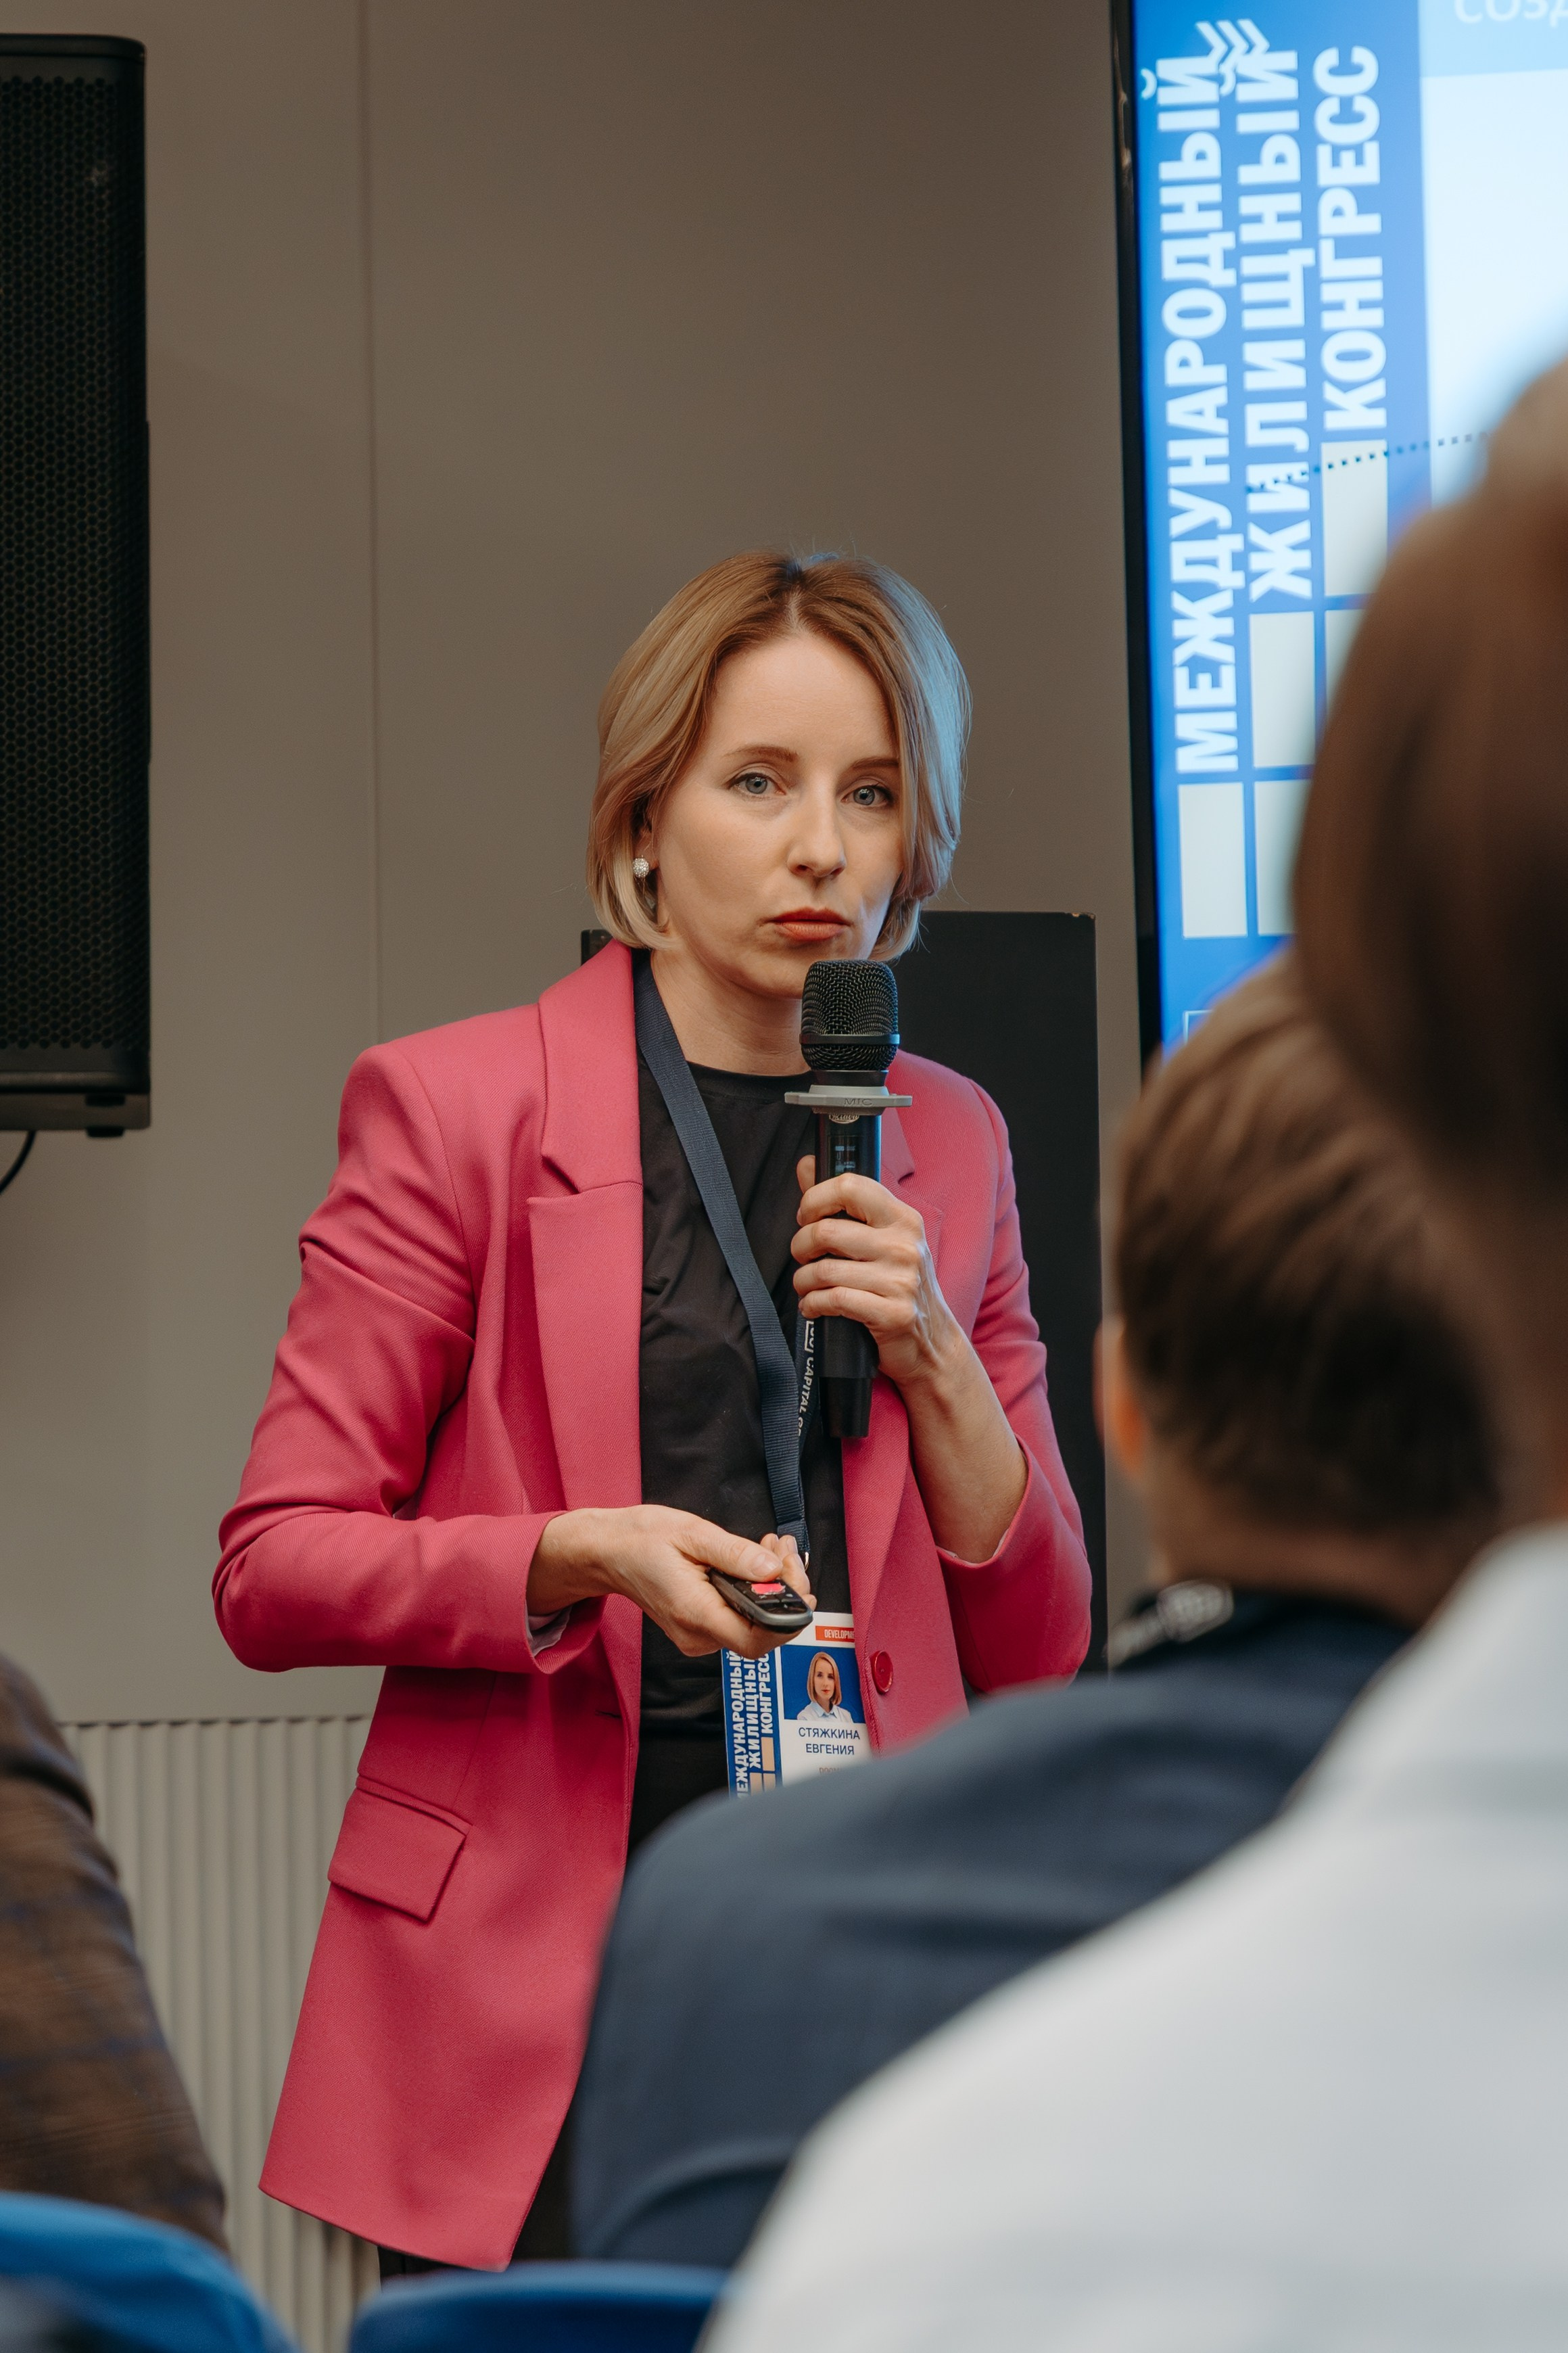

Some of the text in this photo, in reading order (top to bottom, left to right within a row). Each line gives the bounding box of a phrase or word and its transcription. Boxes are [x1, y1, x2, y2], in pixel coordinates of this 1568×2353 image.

[1219, 50, 1316, 601] ЖИЛИЩНЫЙ
[1313, 45, 1387, 431] КОНГРЕСС
[1141, 55, 1245, 773] МЕЖДУНАРОДНЫЙ
[845, 1098, 873, 1106] MIC
[798, 1727, 860, 1740] СТЯЖКИНА
[805, 1743, 855, 1755] ЕВГЕНИЯ
